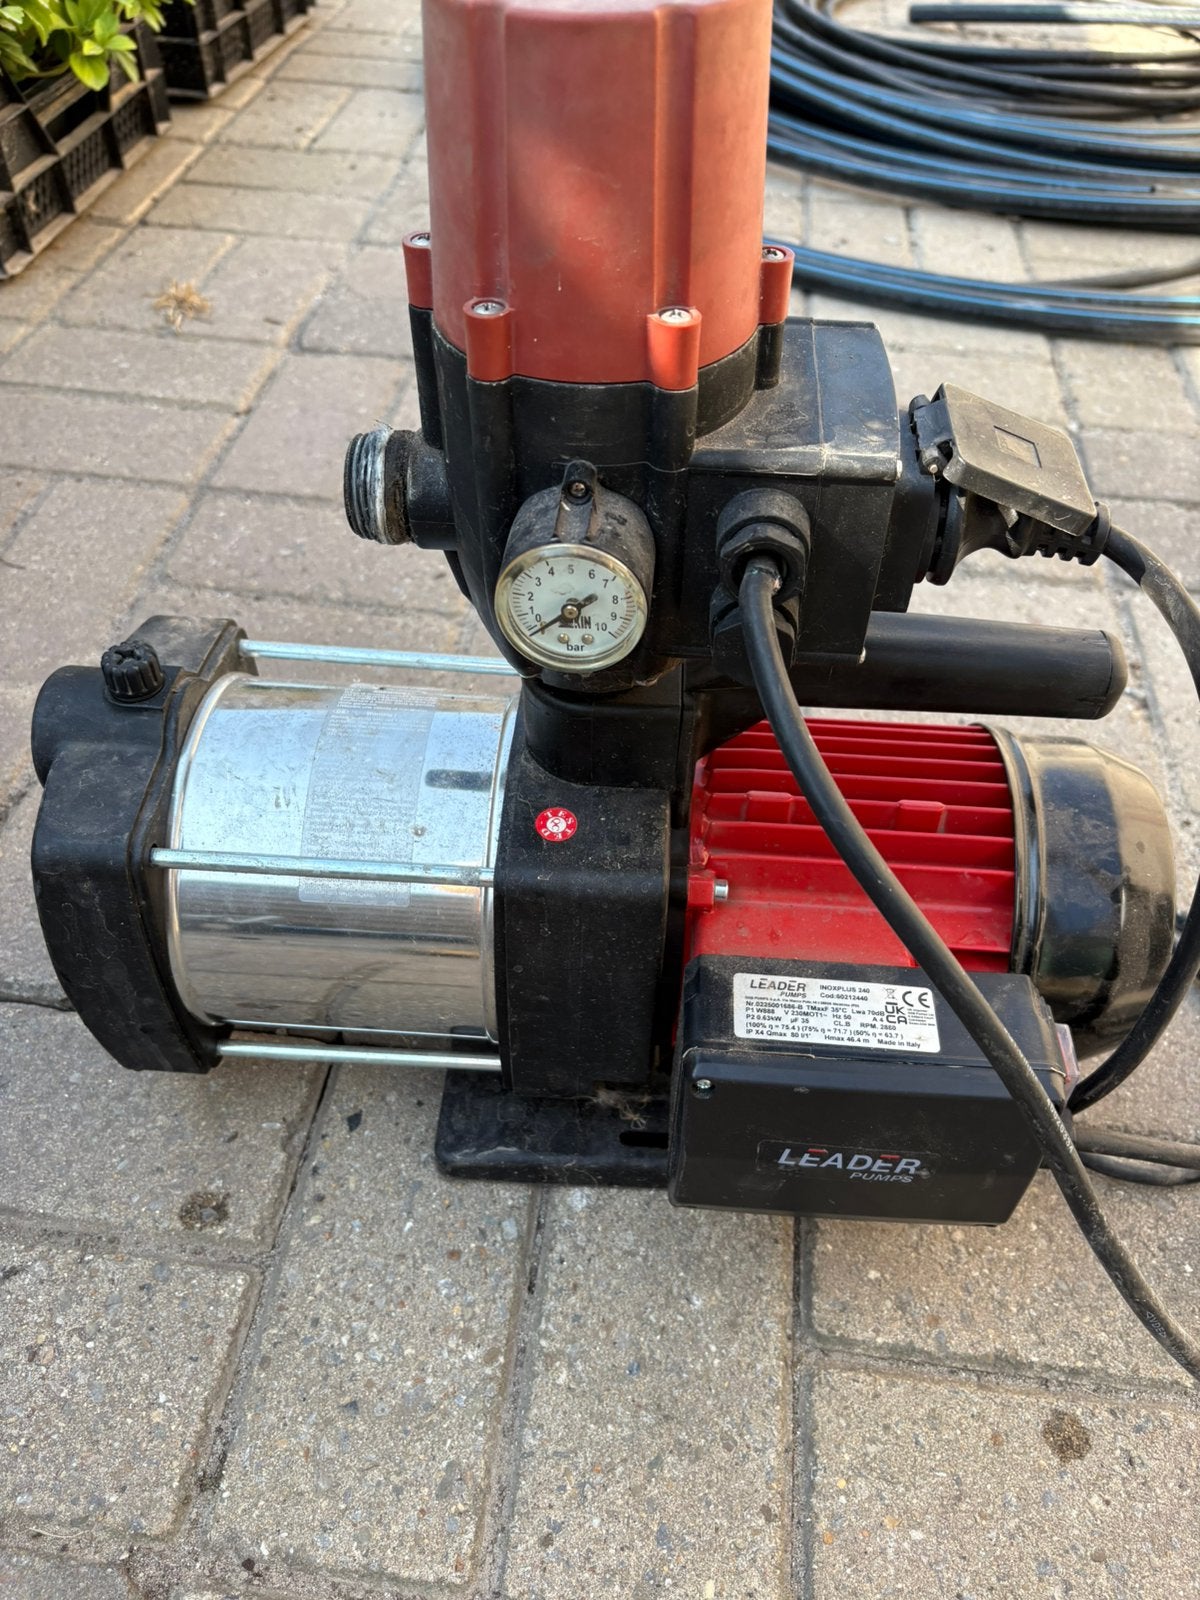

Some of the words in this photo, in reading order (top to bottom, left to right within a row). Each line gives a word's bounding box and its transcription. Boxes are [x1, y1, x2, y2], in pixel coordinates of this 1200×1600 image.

[548, 566, 555, 576] 4
[567, 564, 575, 575] 5
[588, 569, 596, 580] 6
[535, 577, 542, 587] 3
[602, 579, 609, 589] 7
[527, 592, 534, 601] 2
[612, 594, 619, 604] 8
[535, 613, 542, 623] 0
[610, 612, 617, 621] 9
[594, 622, 608, 632] 10
[566, 642, 585, 652] bar
[540, 810, 575, 840] TESTED
[749, 977, 807, 992] LEADER
[780, 991, 807, 999] PUMPS
[906, 1041, 921, 1049] Italy
[777, 1148, 921, 1174] LEADER
[850, 1172, 914, 1183] PUMPS
